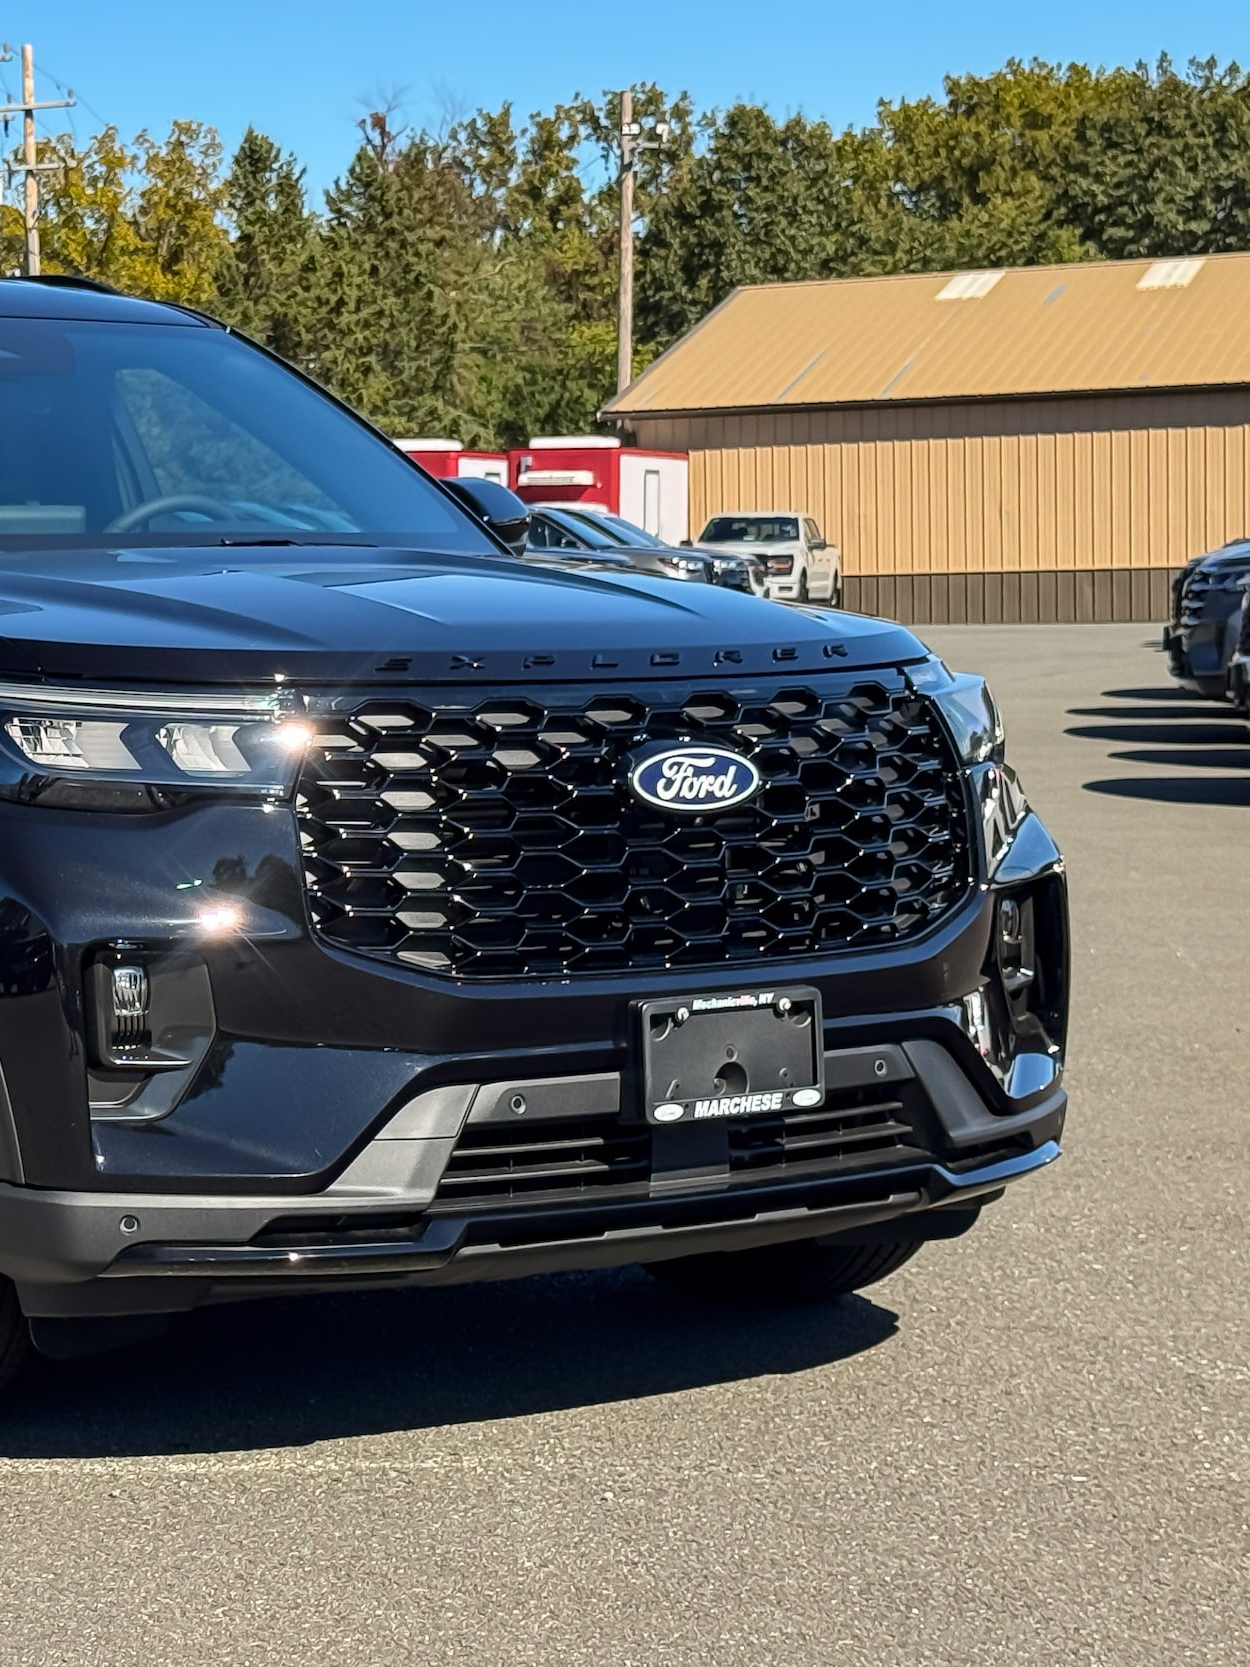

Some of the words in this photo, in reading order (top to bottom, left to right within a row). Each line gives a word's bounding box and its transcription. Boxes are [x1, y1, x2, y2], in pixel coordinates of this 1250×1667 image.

[374, 644, 848, 671] EXPLORER
[656, 756, 738, 801] Ford
[694, 1093, 784, 1118] MARCHESE
